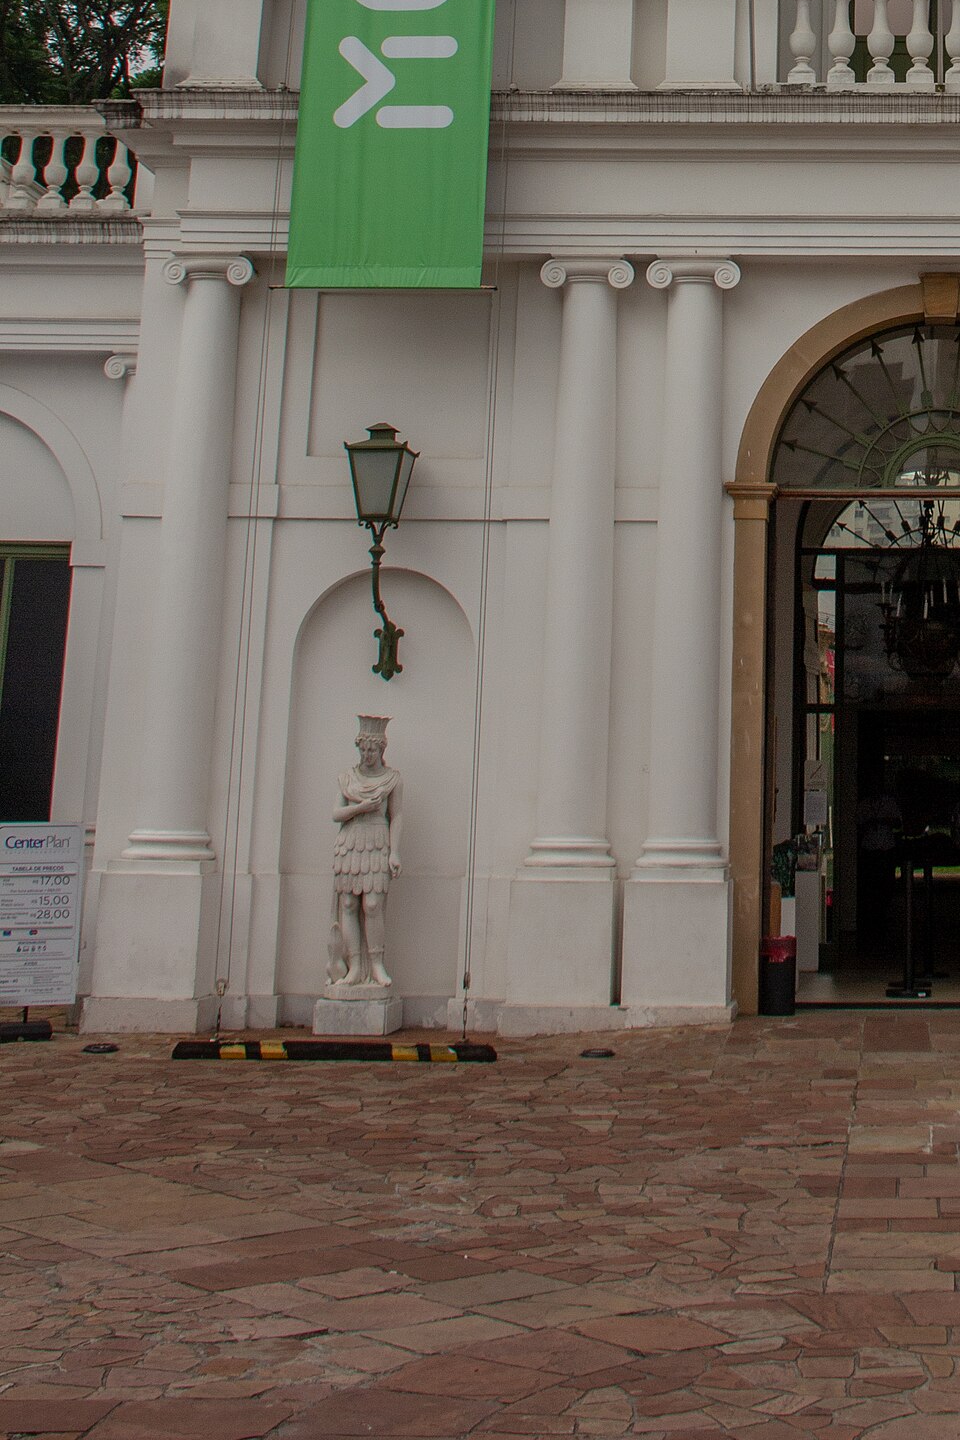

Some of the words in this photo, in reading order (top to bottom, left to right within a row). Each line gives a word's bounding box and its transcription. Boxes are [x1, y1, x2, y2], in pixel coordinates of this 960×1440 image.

[40, 875, 71, 886] 17,00
[39, 895, 70, 906] 15,00
[36, 909, 70, 920] 28,00
